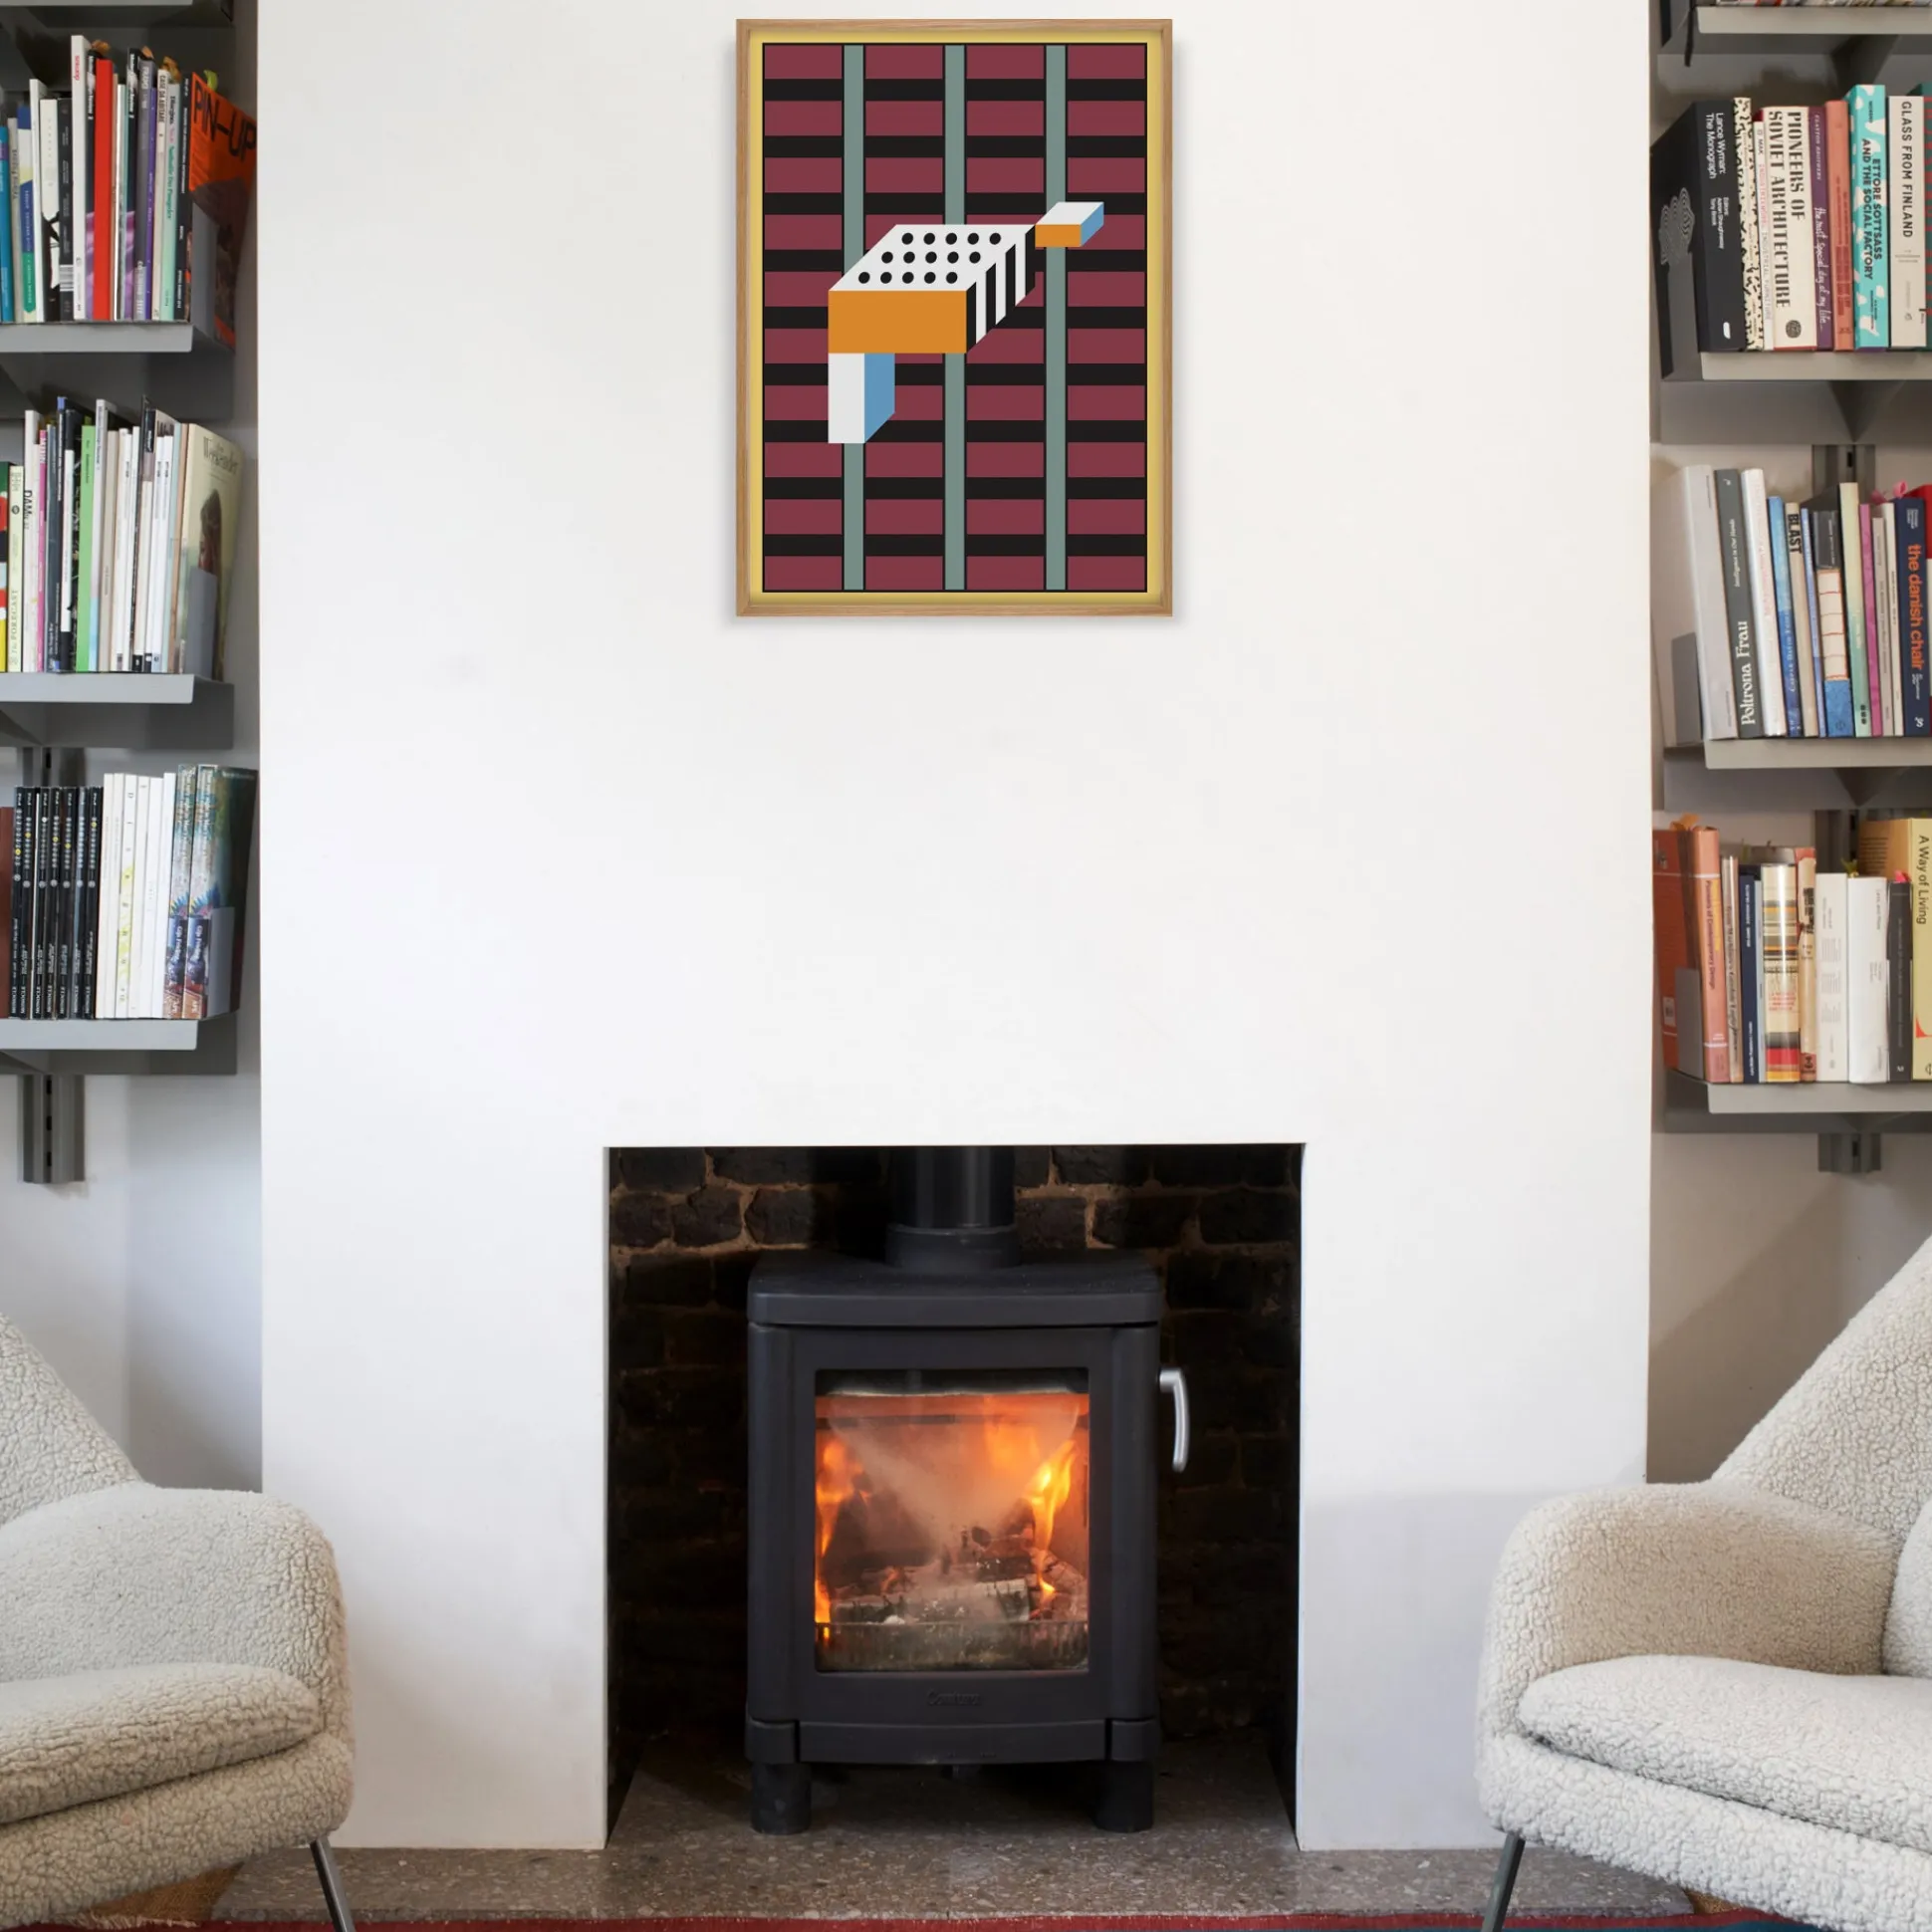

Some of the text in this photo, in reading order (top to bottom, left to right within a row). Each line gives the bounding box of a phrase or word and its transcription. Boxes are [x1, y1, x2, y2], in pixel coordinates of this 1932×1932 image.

[193, 80, 256, 162] PIN-UP
[1715, 113, 1726, 138] Lance
[1706, 113, 1718, 179] The Monograph
[1861, 138, 1872, 163] AND
[1788, 112, 1806, 222] PIONEERS OF
[1862, 165, 1872, 185] THE
[1901, 101, 1914, 238] GLASS FROM FINLAND
[1768, 111, 1791, 309] SOVIET ARCHITECTURE
[1813, 206, 1826, 219] the
[1862, 188, 1872, 229] SOCIAL
[1872, 158, 1883, 260] ETTORE SOTTSASS
[1815, 220, 1829, 239] most
[1863, 231, 1873, 280] FACTORY
[1814, 270, 1828, 284] day
[1818, 285, 1830, 295] of
[1815, 297, 1826, 307] my
[1788, 513, 1803, 555] BLAST
[1907, 544, 1922, 571] the
[1908, 575, 1923, 625] danish
[1909, 630, 1924, 670] chair
[1736, 620, 1756, 726] Poltrona Frau
[1916, 835, 1930, 925] A Way of Living
